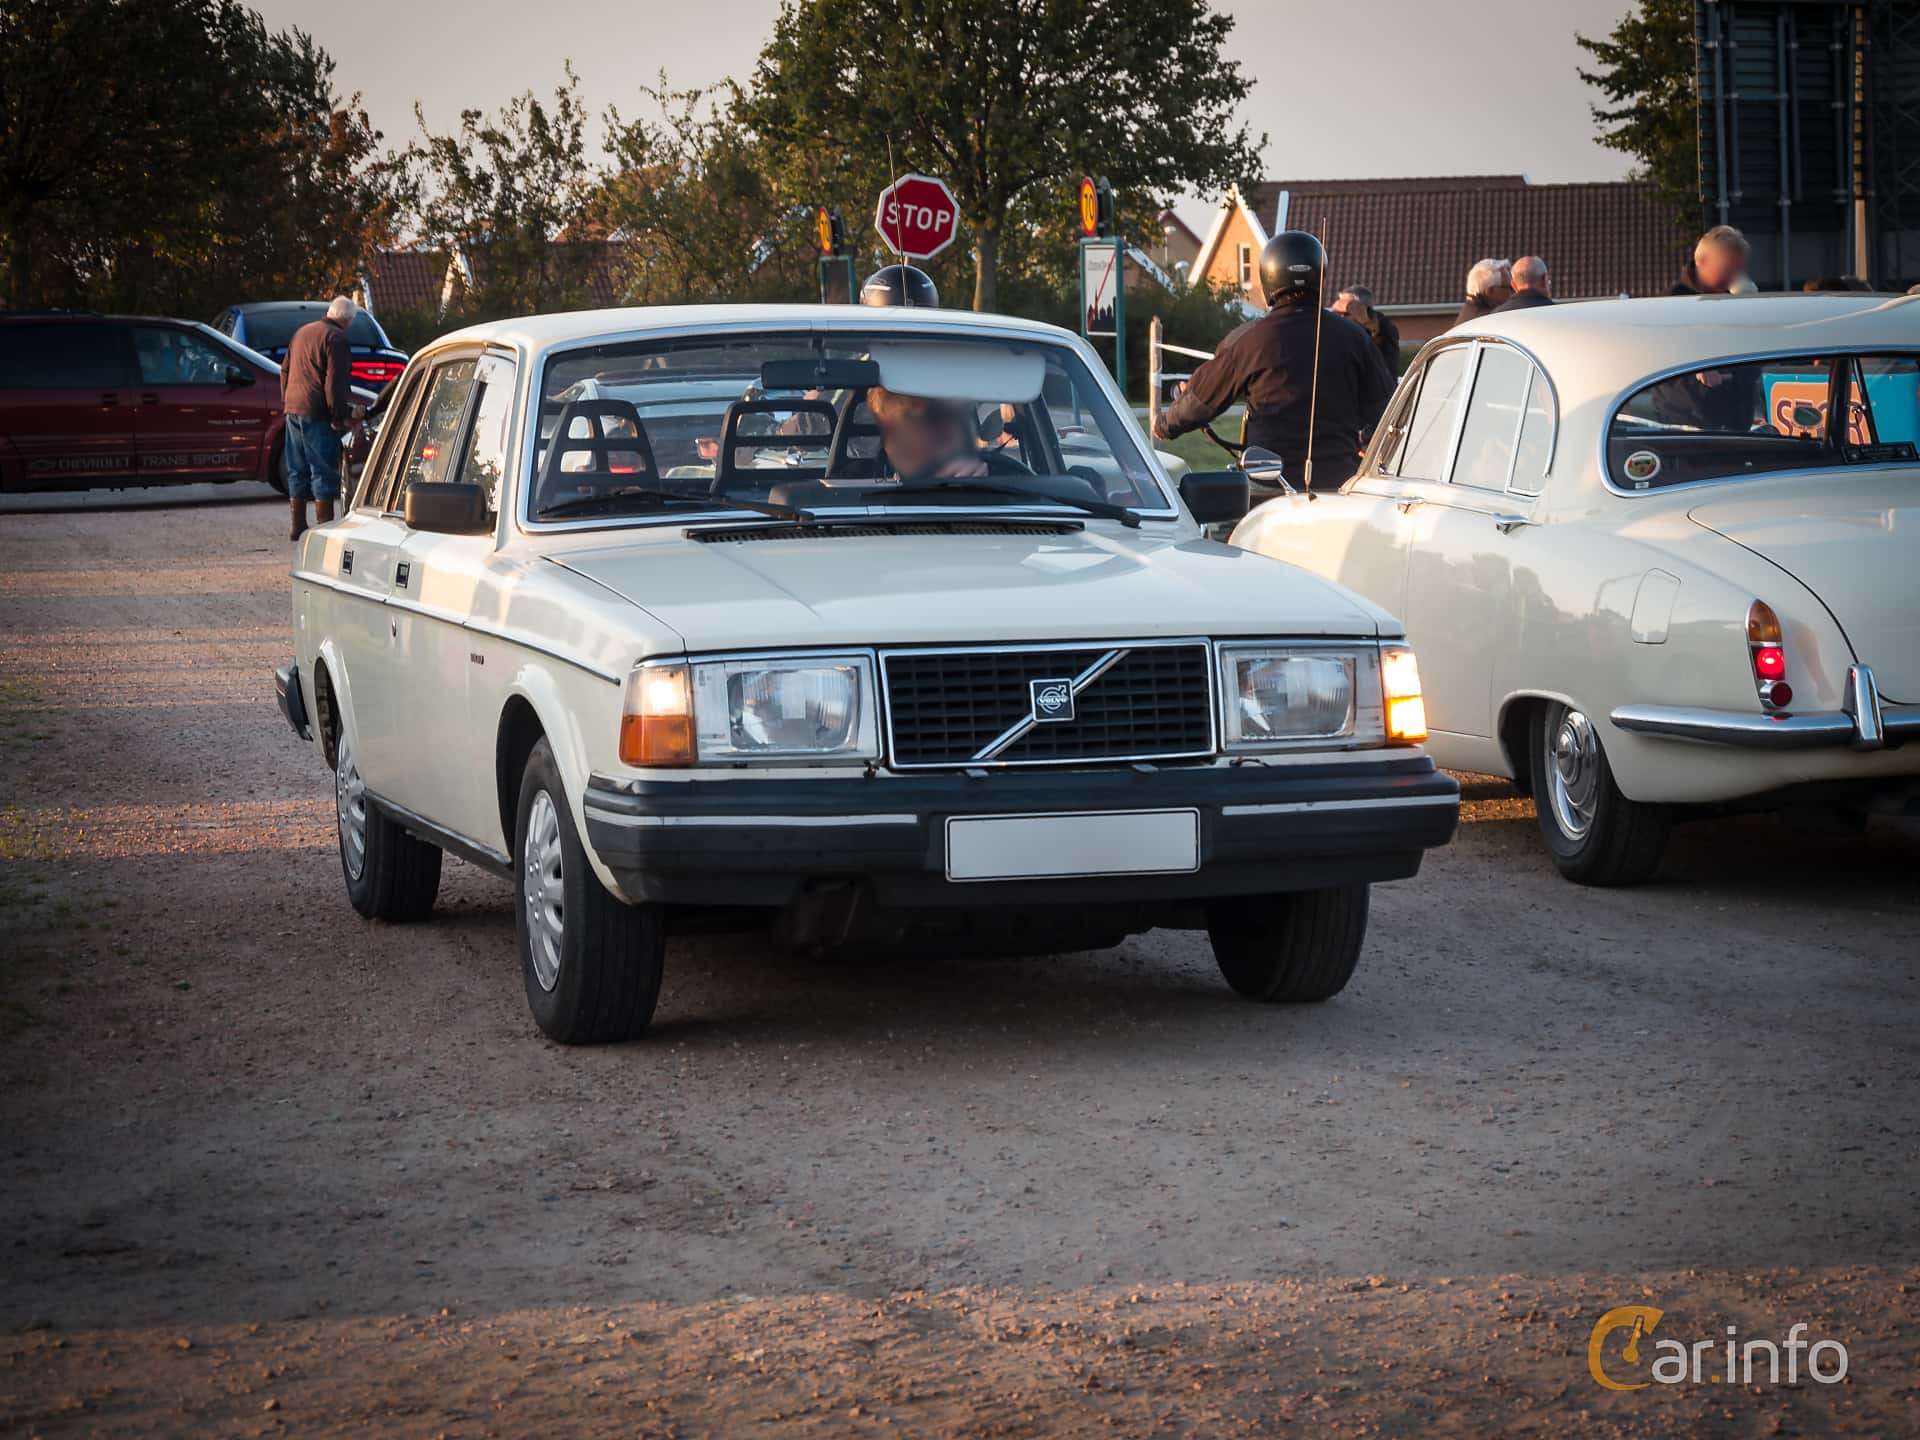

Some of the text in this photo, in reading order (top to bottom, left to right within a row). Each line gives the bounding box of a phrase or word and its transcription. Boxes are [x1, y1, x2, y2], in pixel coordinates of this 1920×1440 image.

[886, 201, 951, 233] STOP
[143, 455, 186, 467] TRANS
[193, 453, 241, 465] SPORT
